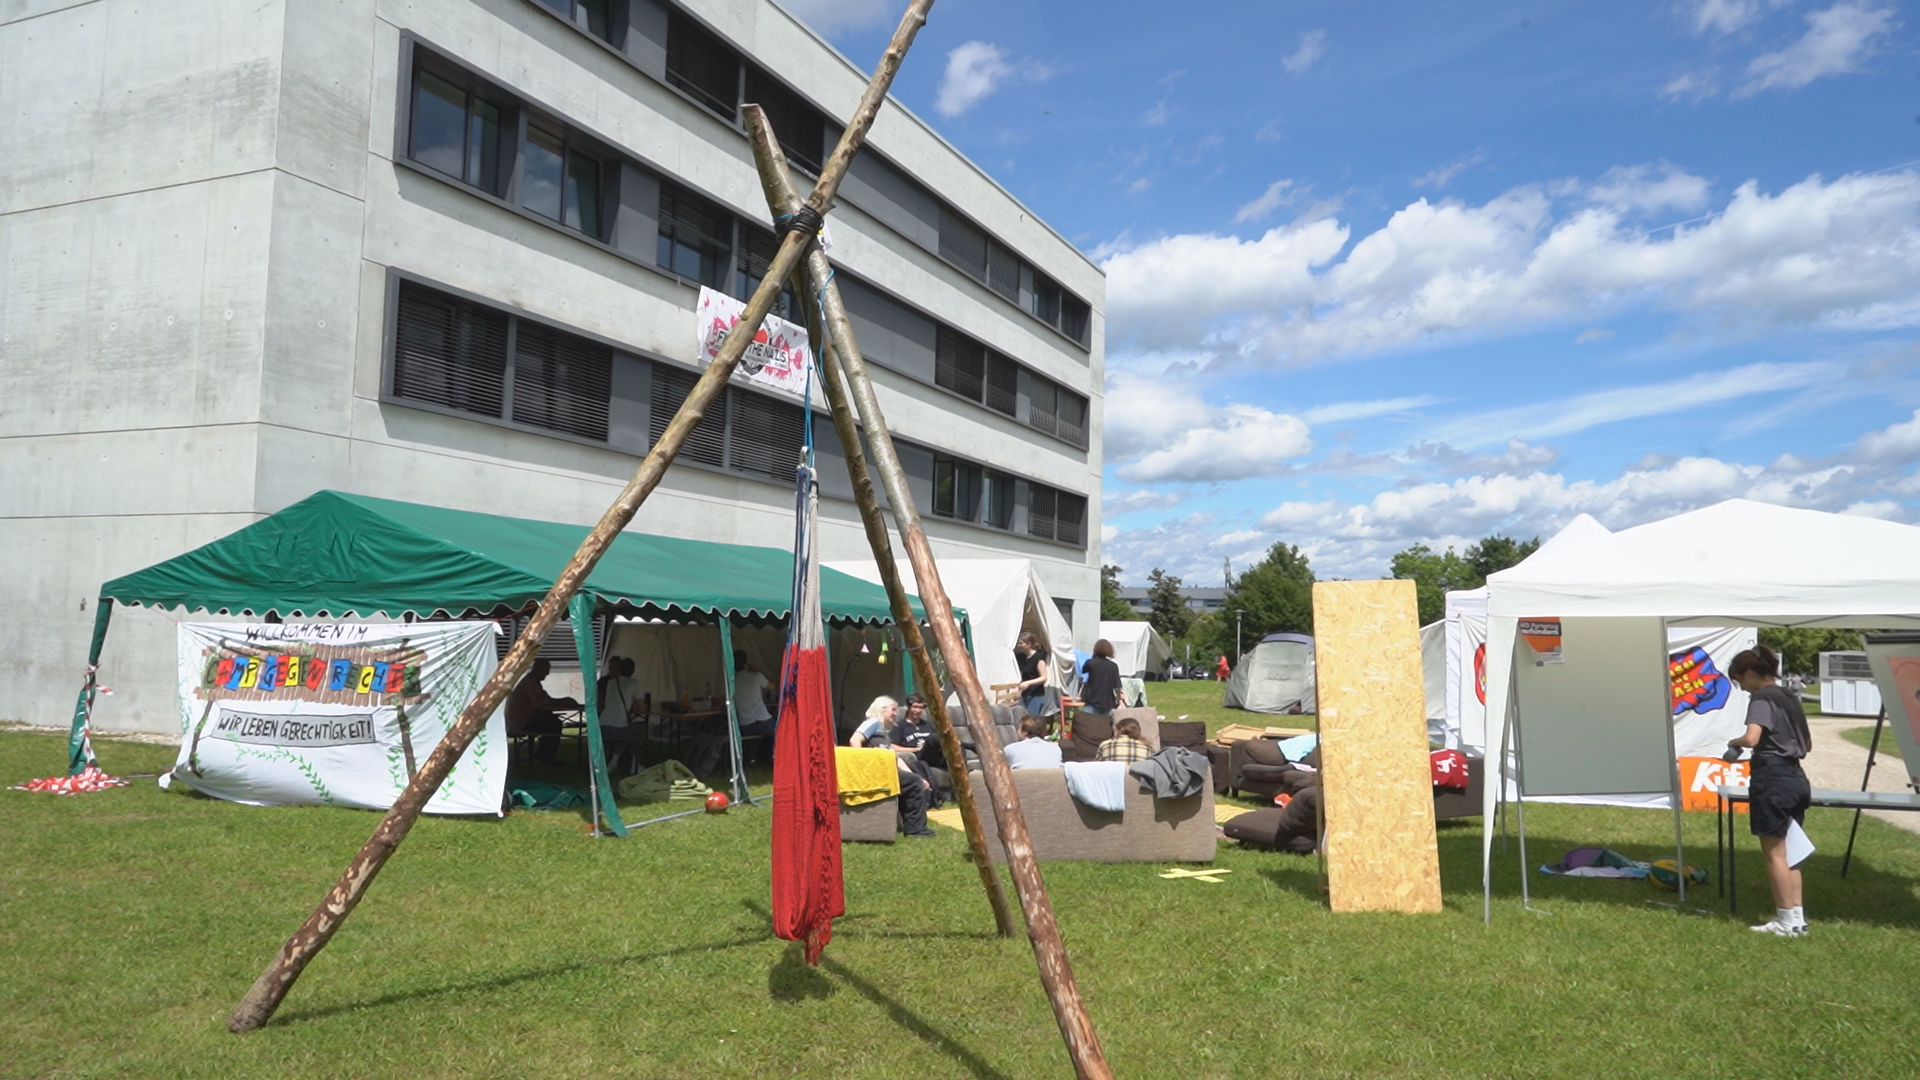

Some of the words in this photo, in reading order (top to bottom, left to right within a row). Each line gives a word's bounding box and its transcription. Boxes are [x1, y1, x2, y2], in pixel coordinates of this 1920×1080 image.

[245, 623, 344, 642] WILLKOMMEN
[347, 626, 368, 640] IM
[205, 660, 259, 685] CAMP
[264, 660, 323, 688] GEGEN
[1669, 659, 1695, 677] ASH
[1673, 678, 1704, 697] ASH
[240, 717, 279, 737] LEBEN
